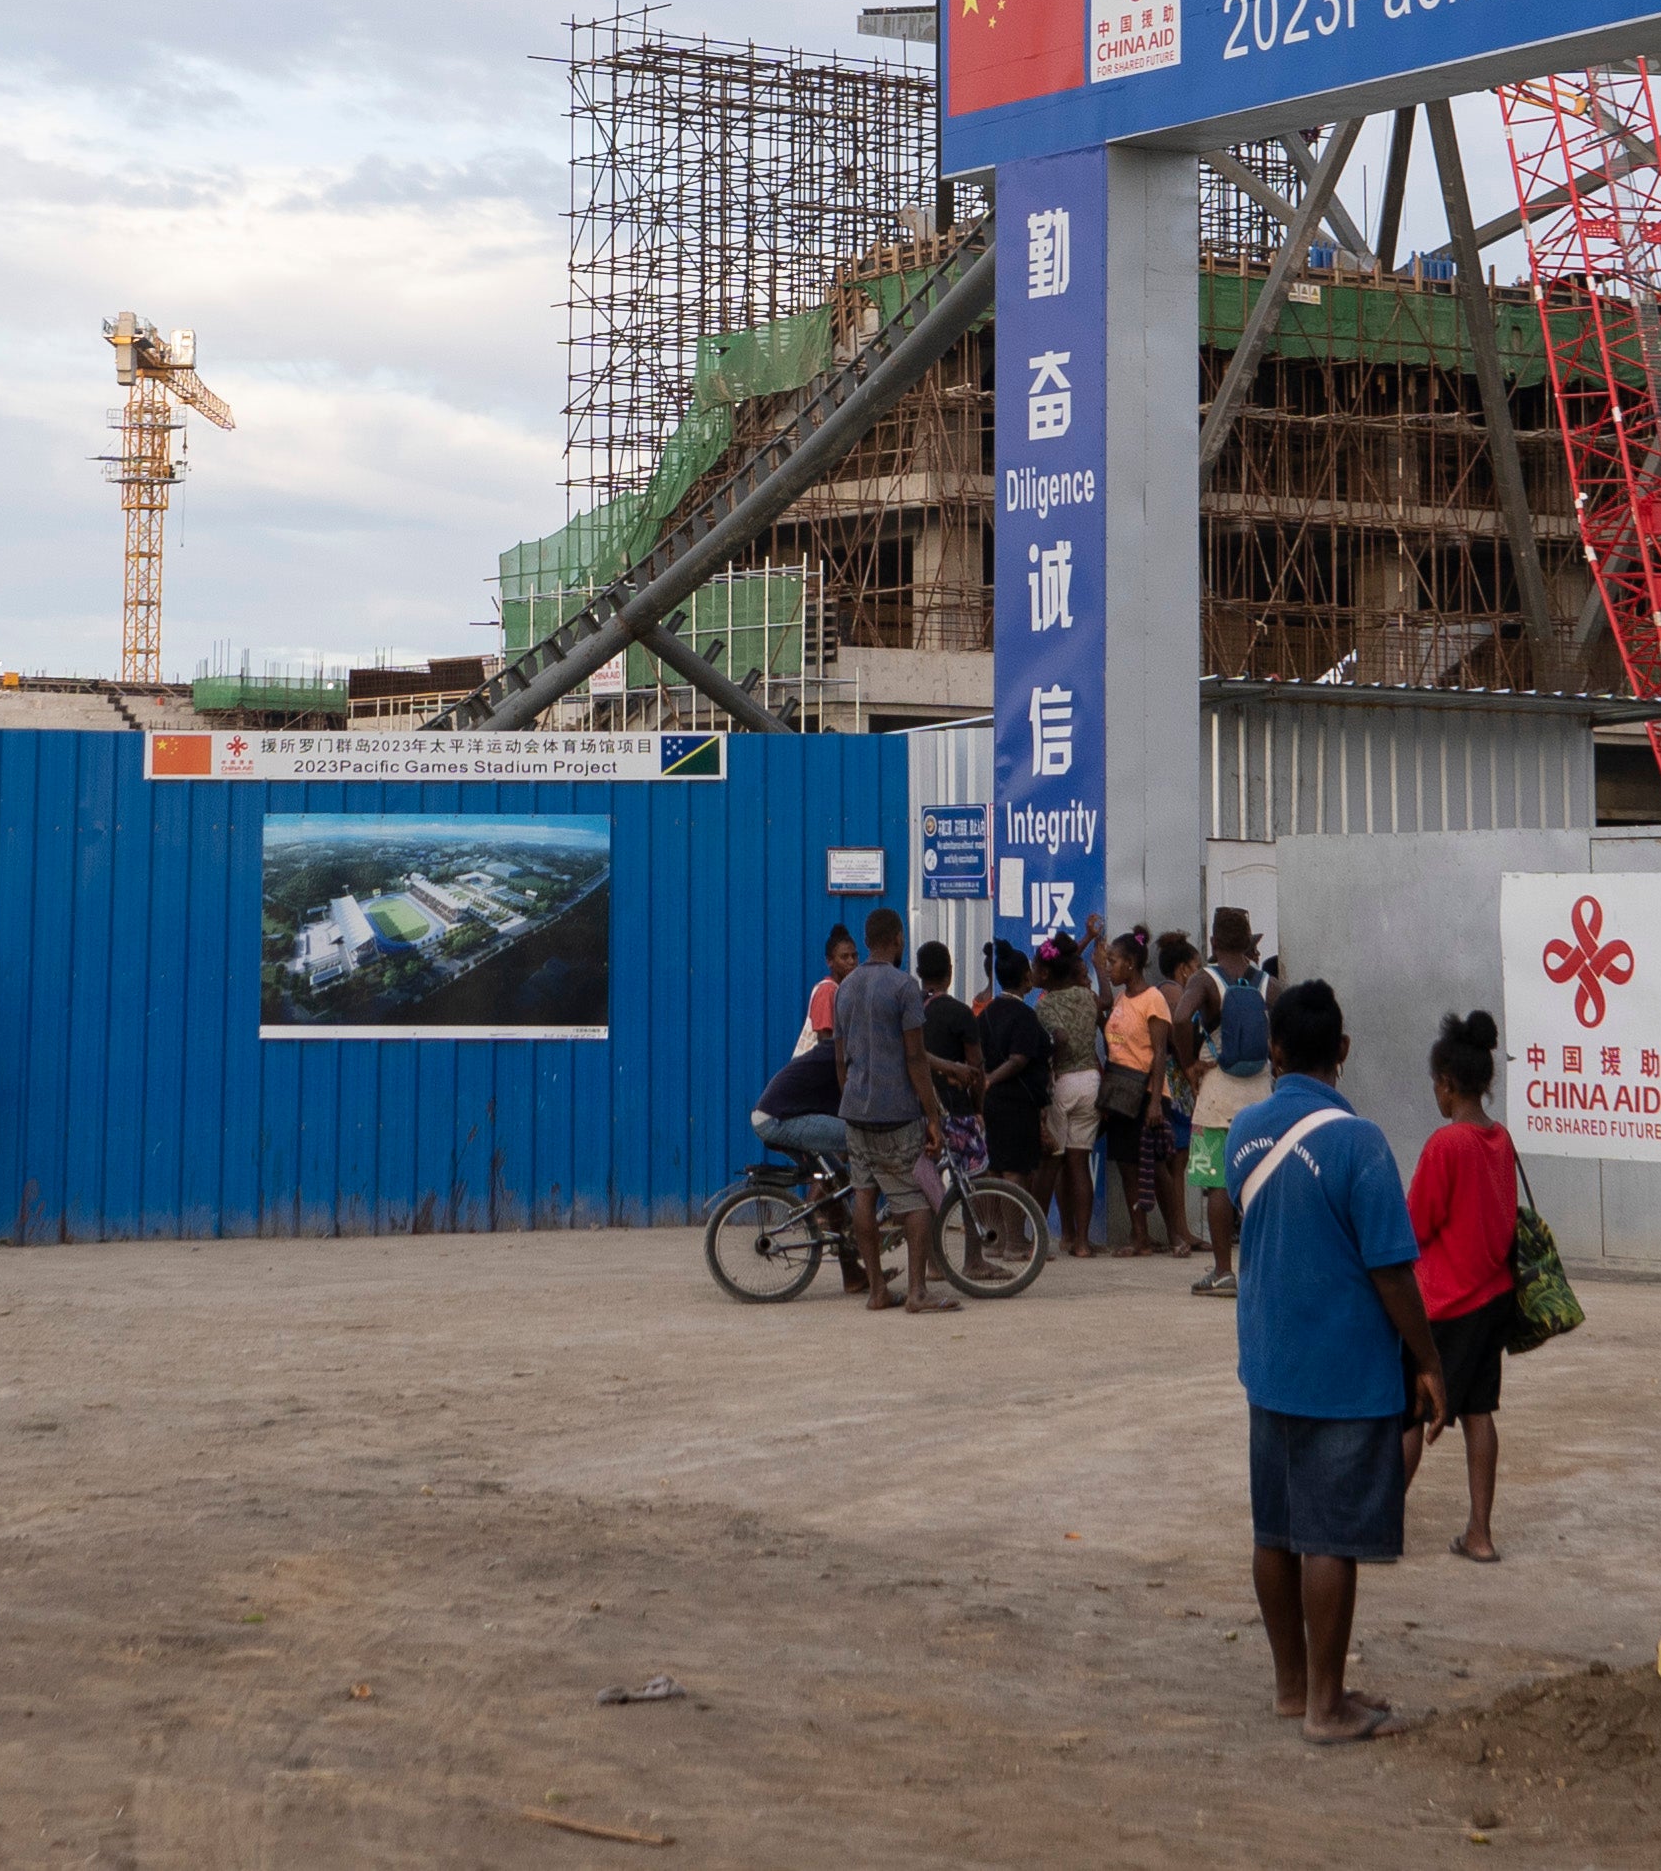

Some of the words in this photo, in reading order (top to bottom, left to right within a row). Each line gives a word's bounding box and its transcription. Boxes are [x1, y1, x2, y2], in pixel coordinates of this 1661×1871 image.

[1097, 35, 1146, 62] CHINA
[1148, 28, 1175, 50] AID
[1096, 64, 1113, 78] FOR
[1114, 58, 1145, 73] SHARED
[1146, 50, 1175, 68] FUTURE
[1005, 468, 1095, 519] Diligence
[261, 737, 652, 754] 援所罗门群岛2023年太平洋运动会体育场馆项目
[294, 760, 402, 774] 2023Pacific
[405, 760, 469, 774] Games
[474, 760, 548, 774] Stadium
[553, 760, 618, 776] Project
[1006, 799, 1097, 855] Integrity
[1526, 1042, 1661, 1079] 中国援助
[1526, 1079, 1609, 1111] CHINA
[1613, 1085, 1661, 1114] AID
[1527, 1115, 1553, 1133] FOR
[1555, 1116, 1608, 1137] SHARED
[1232, 1136, 1275, 1169] FRIENDS
